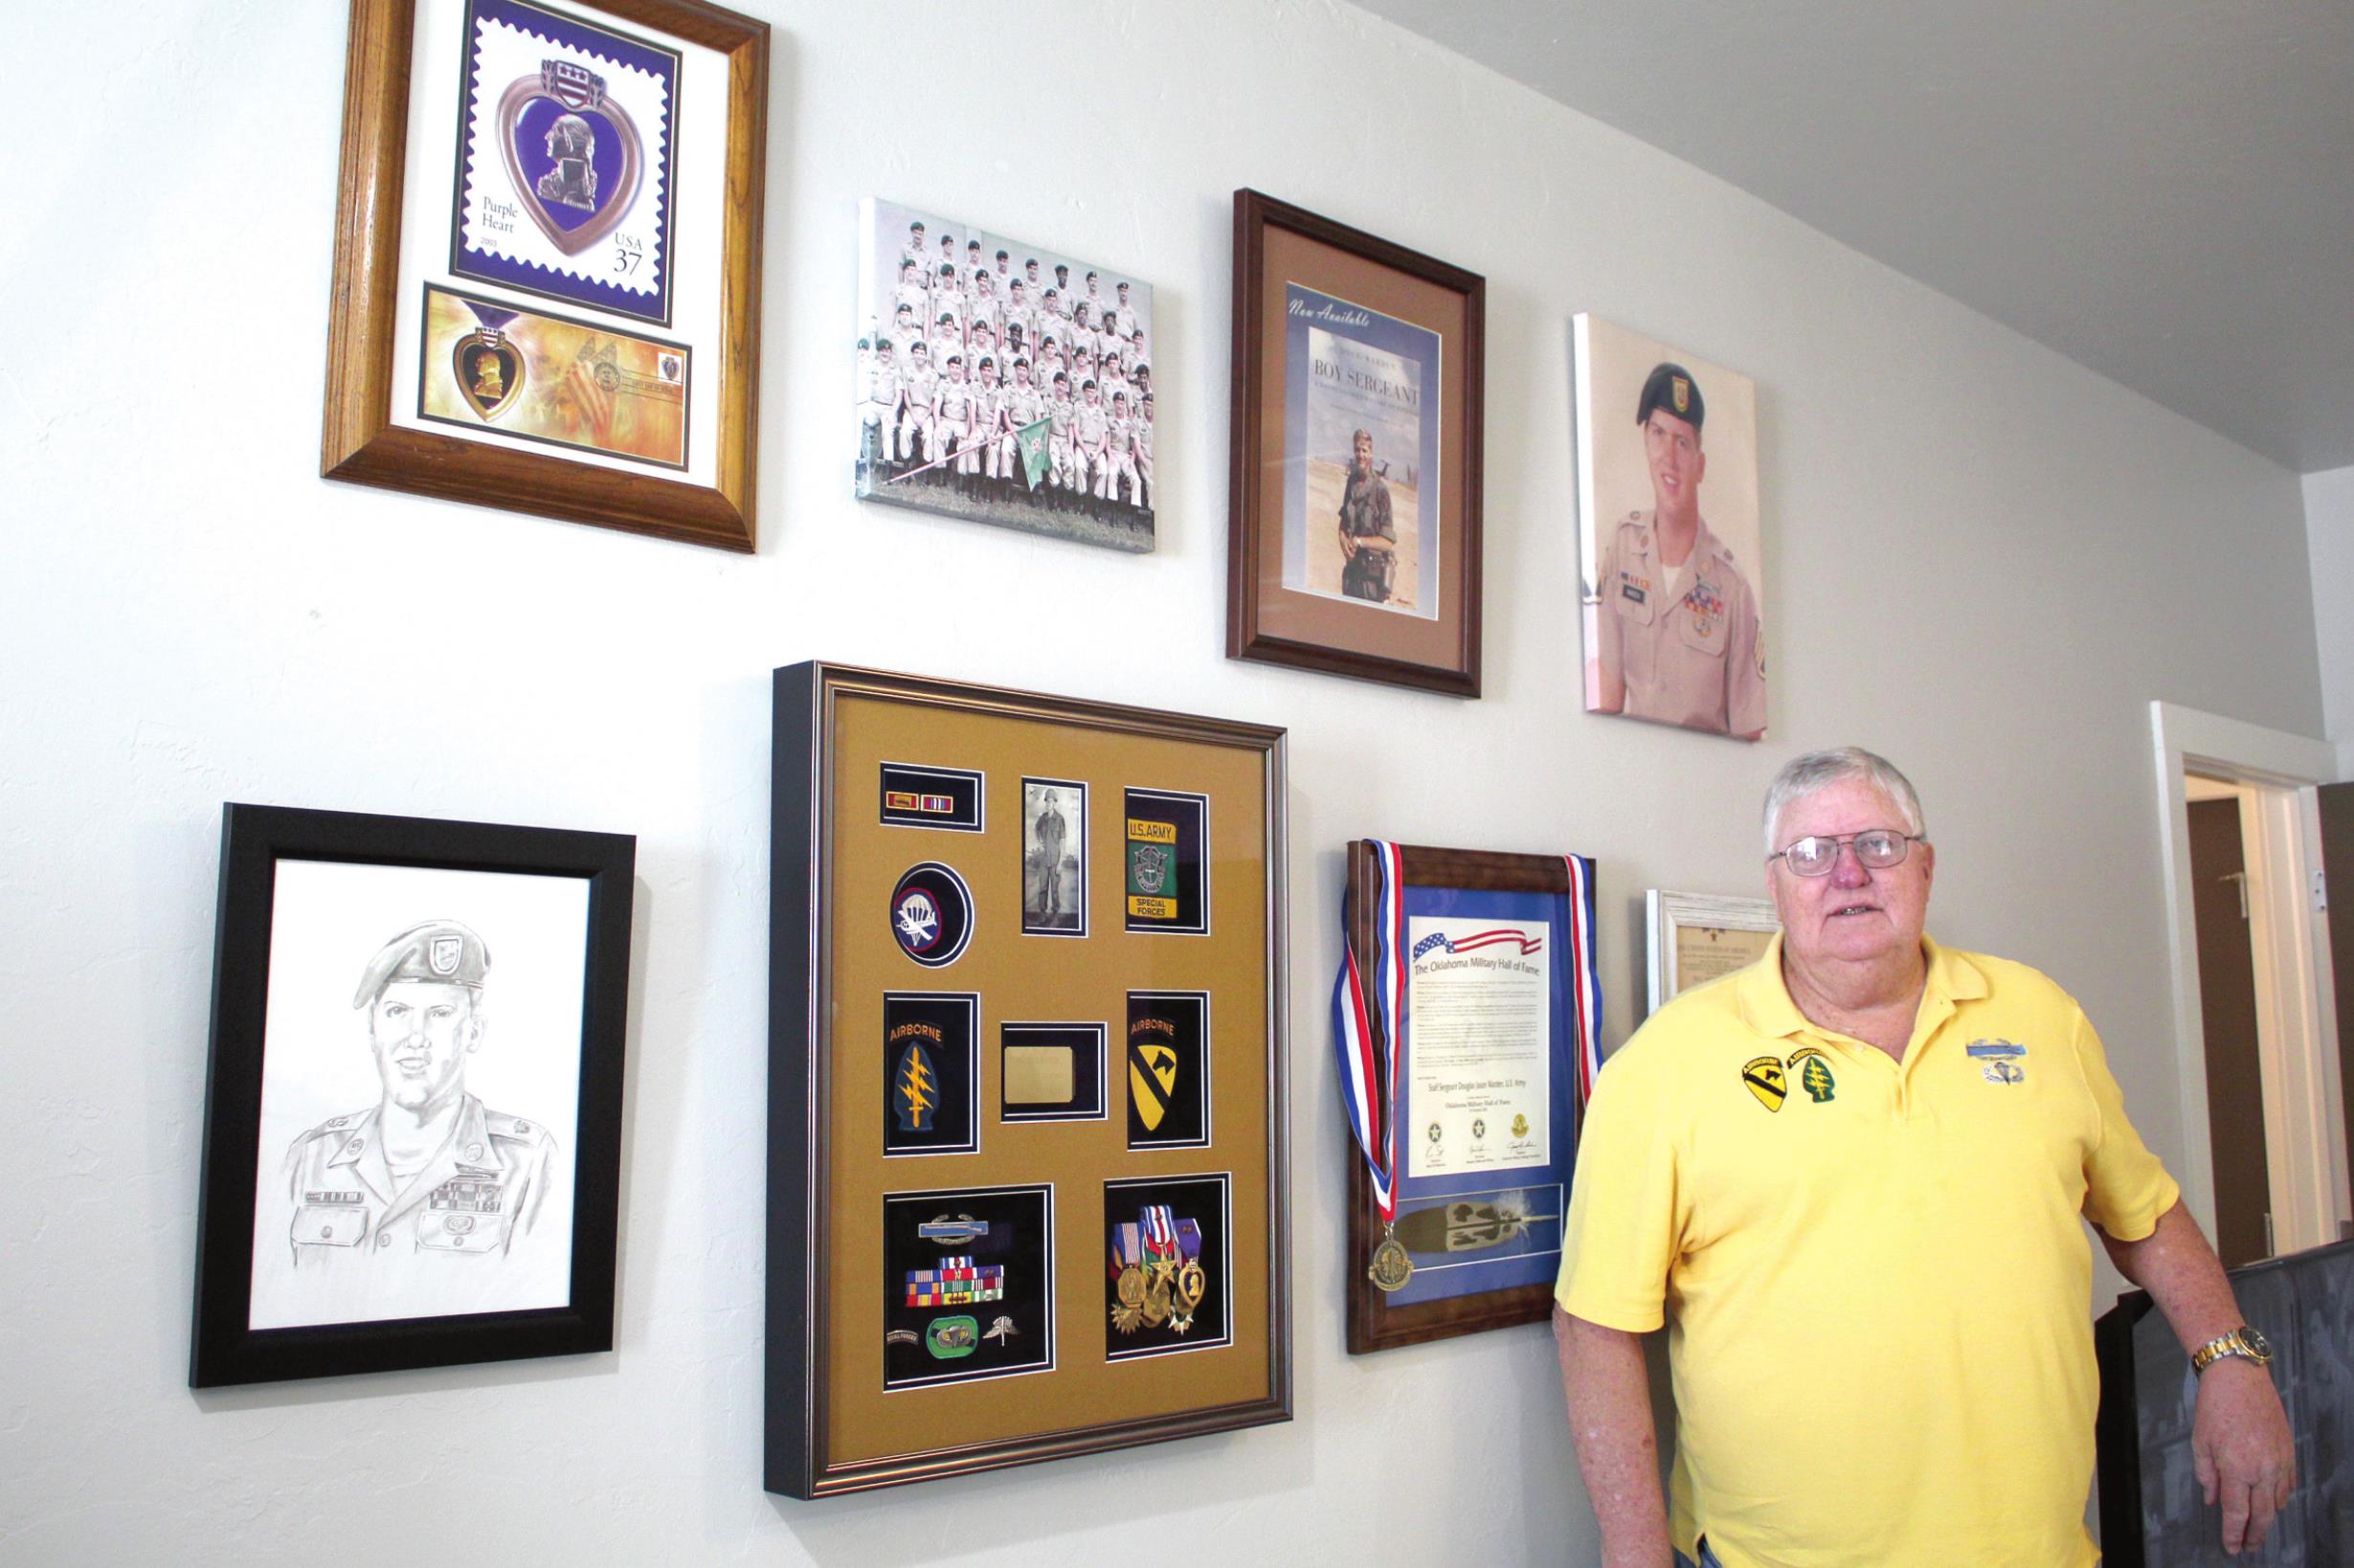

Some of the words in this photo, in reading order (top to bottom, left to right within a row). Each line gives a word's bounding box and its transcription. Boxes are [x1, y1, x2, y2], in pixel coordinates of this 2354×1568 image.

[482, 195, 519, 219] Purple
[482, 213, 514, 234] Heart
[615, 232, 642, 251] USA
[614, 249, 642, 276] 37
[1289, 298, 1313, 318] Now
[1316, 303, 1370, 327] Available
[1314, 359, 1341, 381] BOY
[1347, 370, 1421, 406] SERGEANT
[1136, 898, 1166, 907] SPECIAL
[1136, 907, 1166, 916] FORCES
[1415, 964, 1428, 975] The
[1430, 959, 1468, 973] Oklahoma
[1470, 957, 1497, 971] Military
[1498, 958, 1513, 970] Hall
[1513, 961, 1520, 971] of
[1521, 962, 1540, 976] Fame
[889, 1022, 942, 1042] AIRBORNE
[1131, 1018, 1175, 1036] AIRBORNE
